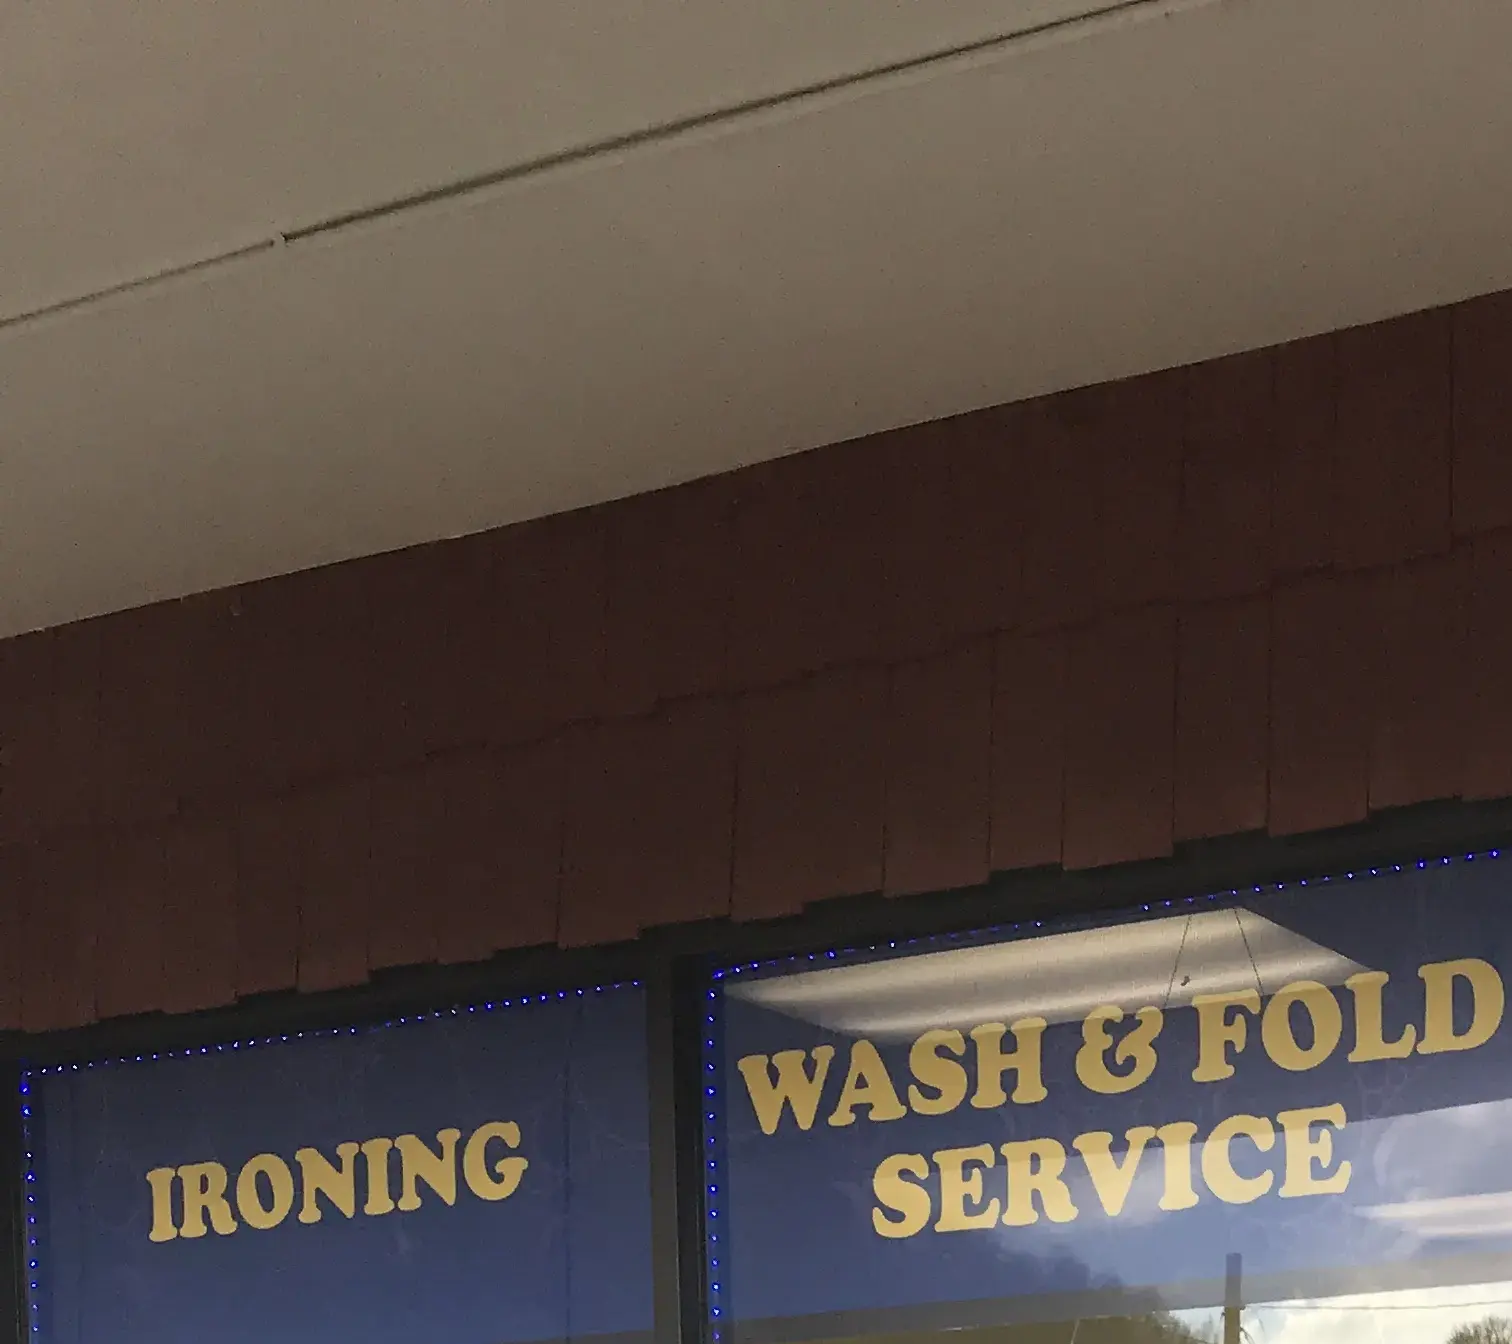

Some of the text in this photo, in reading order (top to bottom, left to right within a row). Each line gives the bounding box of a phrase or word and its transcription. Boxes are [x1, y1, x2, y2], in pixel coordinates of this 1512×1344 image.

[738, 958, 1505, 1135] WASH & FOLD
[146, 1121, 528, 1242] IRONING
[871, 1102, 1352, 1239] SERVICE
